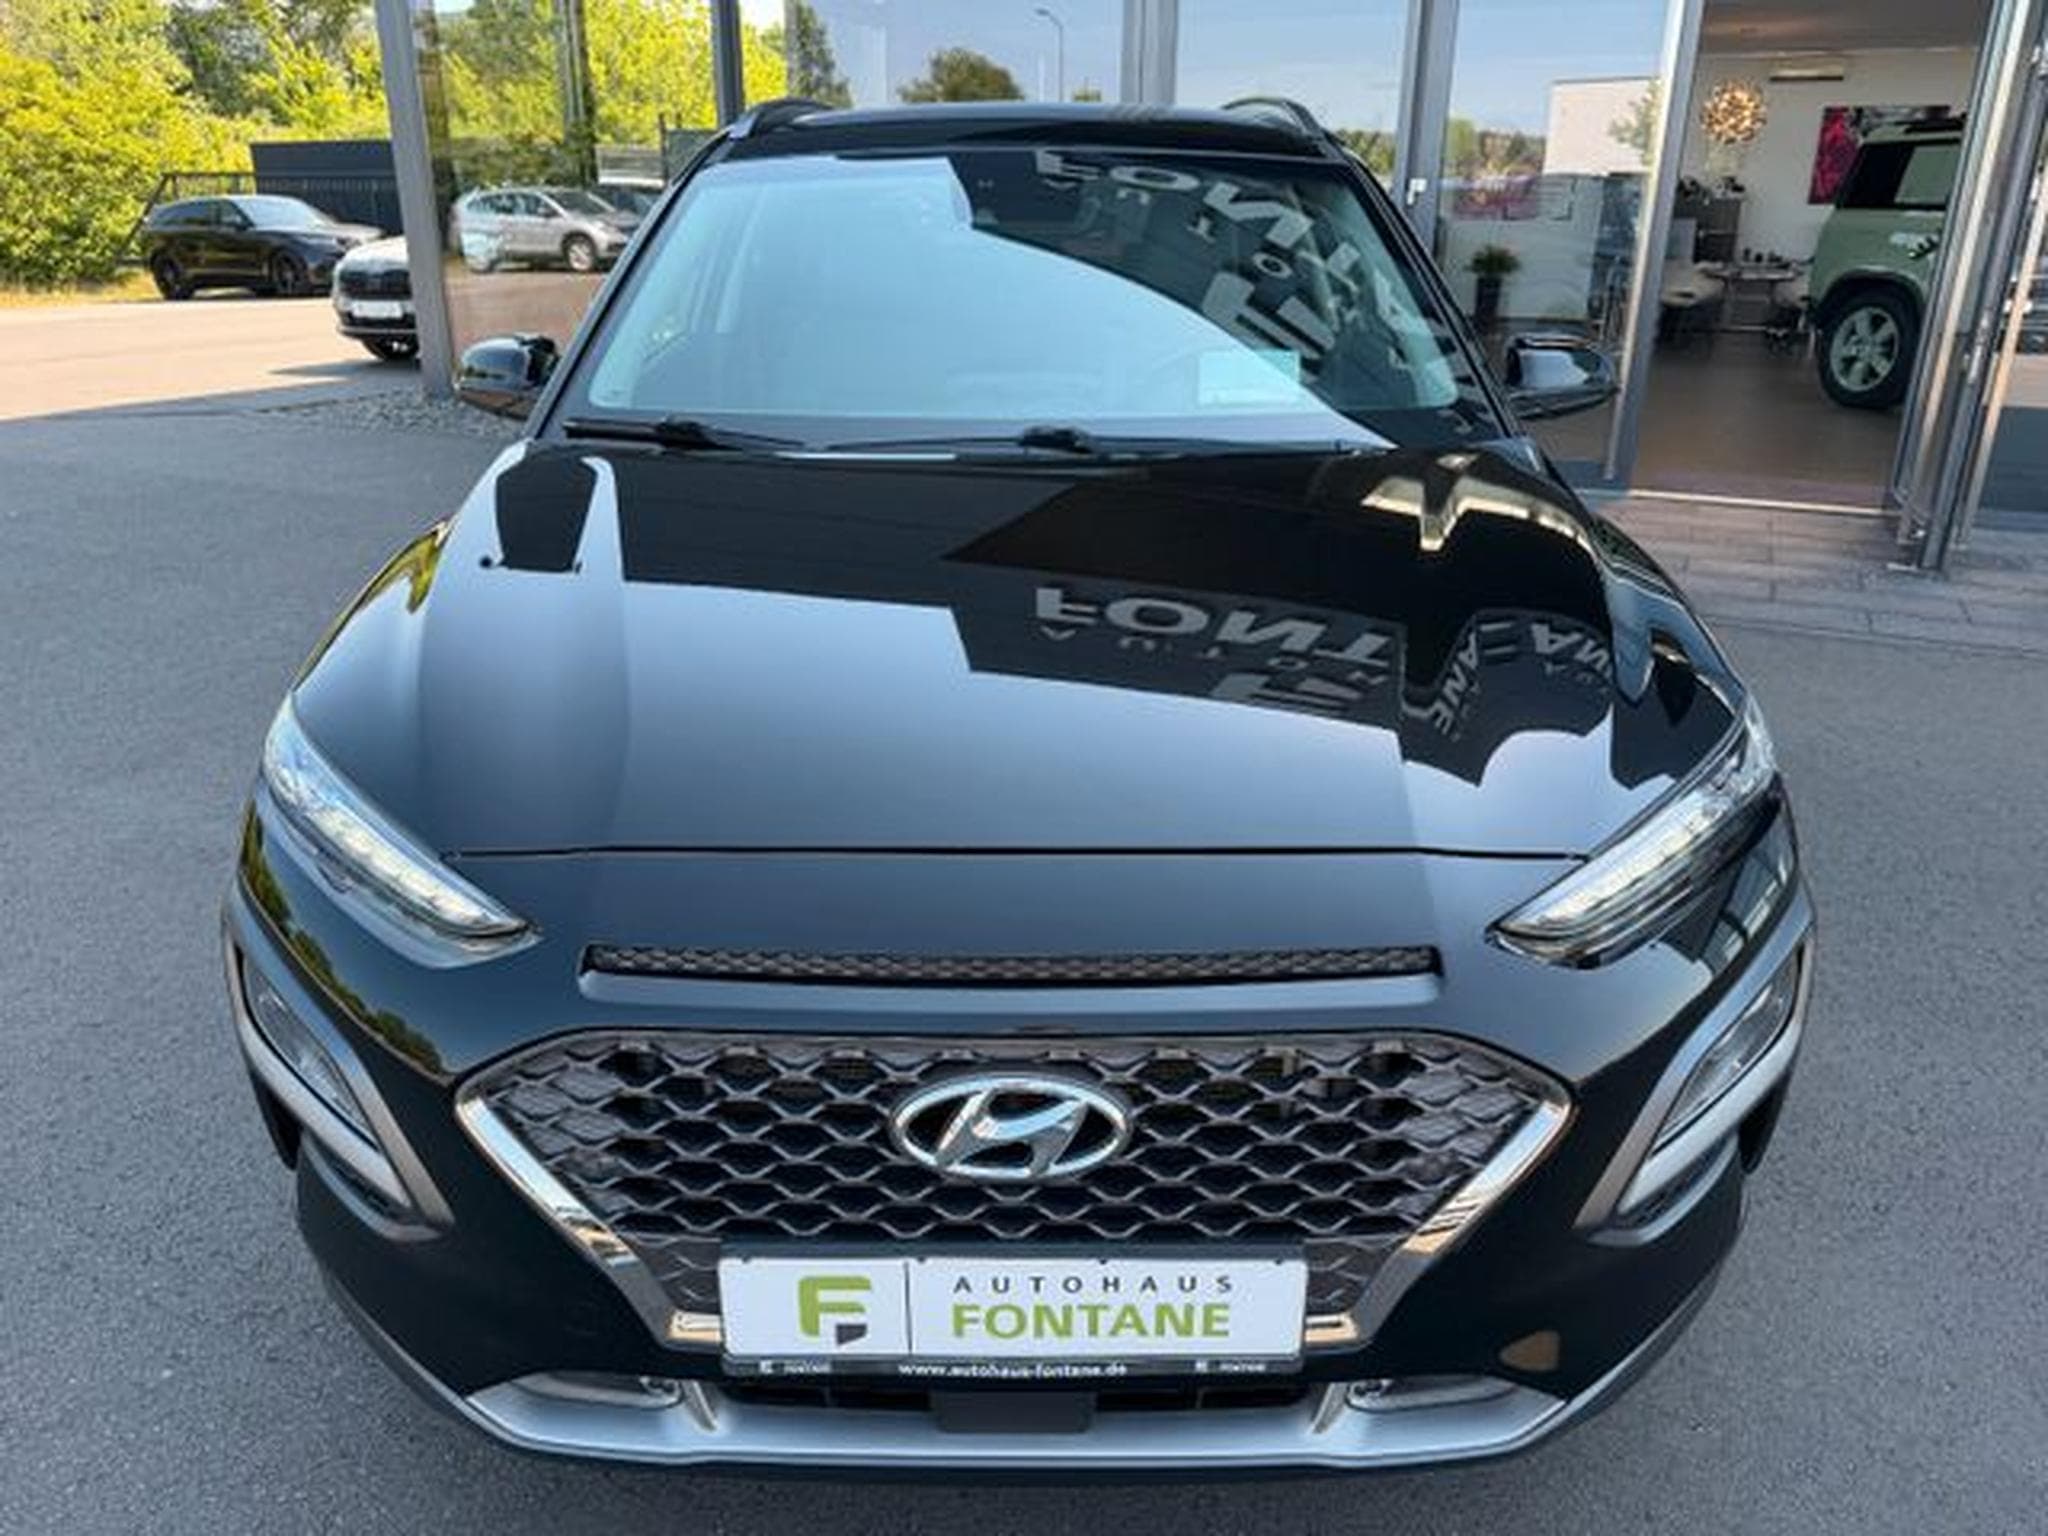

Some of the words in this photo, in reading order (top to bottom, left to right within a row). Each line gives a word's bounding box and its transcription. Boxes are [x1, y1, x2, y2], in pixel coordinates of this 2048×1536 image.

[953, 1275, 1233, 1294] AUTOHAUS
[952, 1302, 1230, 1339] FONTANE
[898, 1360, 1128, 1379] www.autohaus-fontane.de
